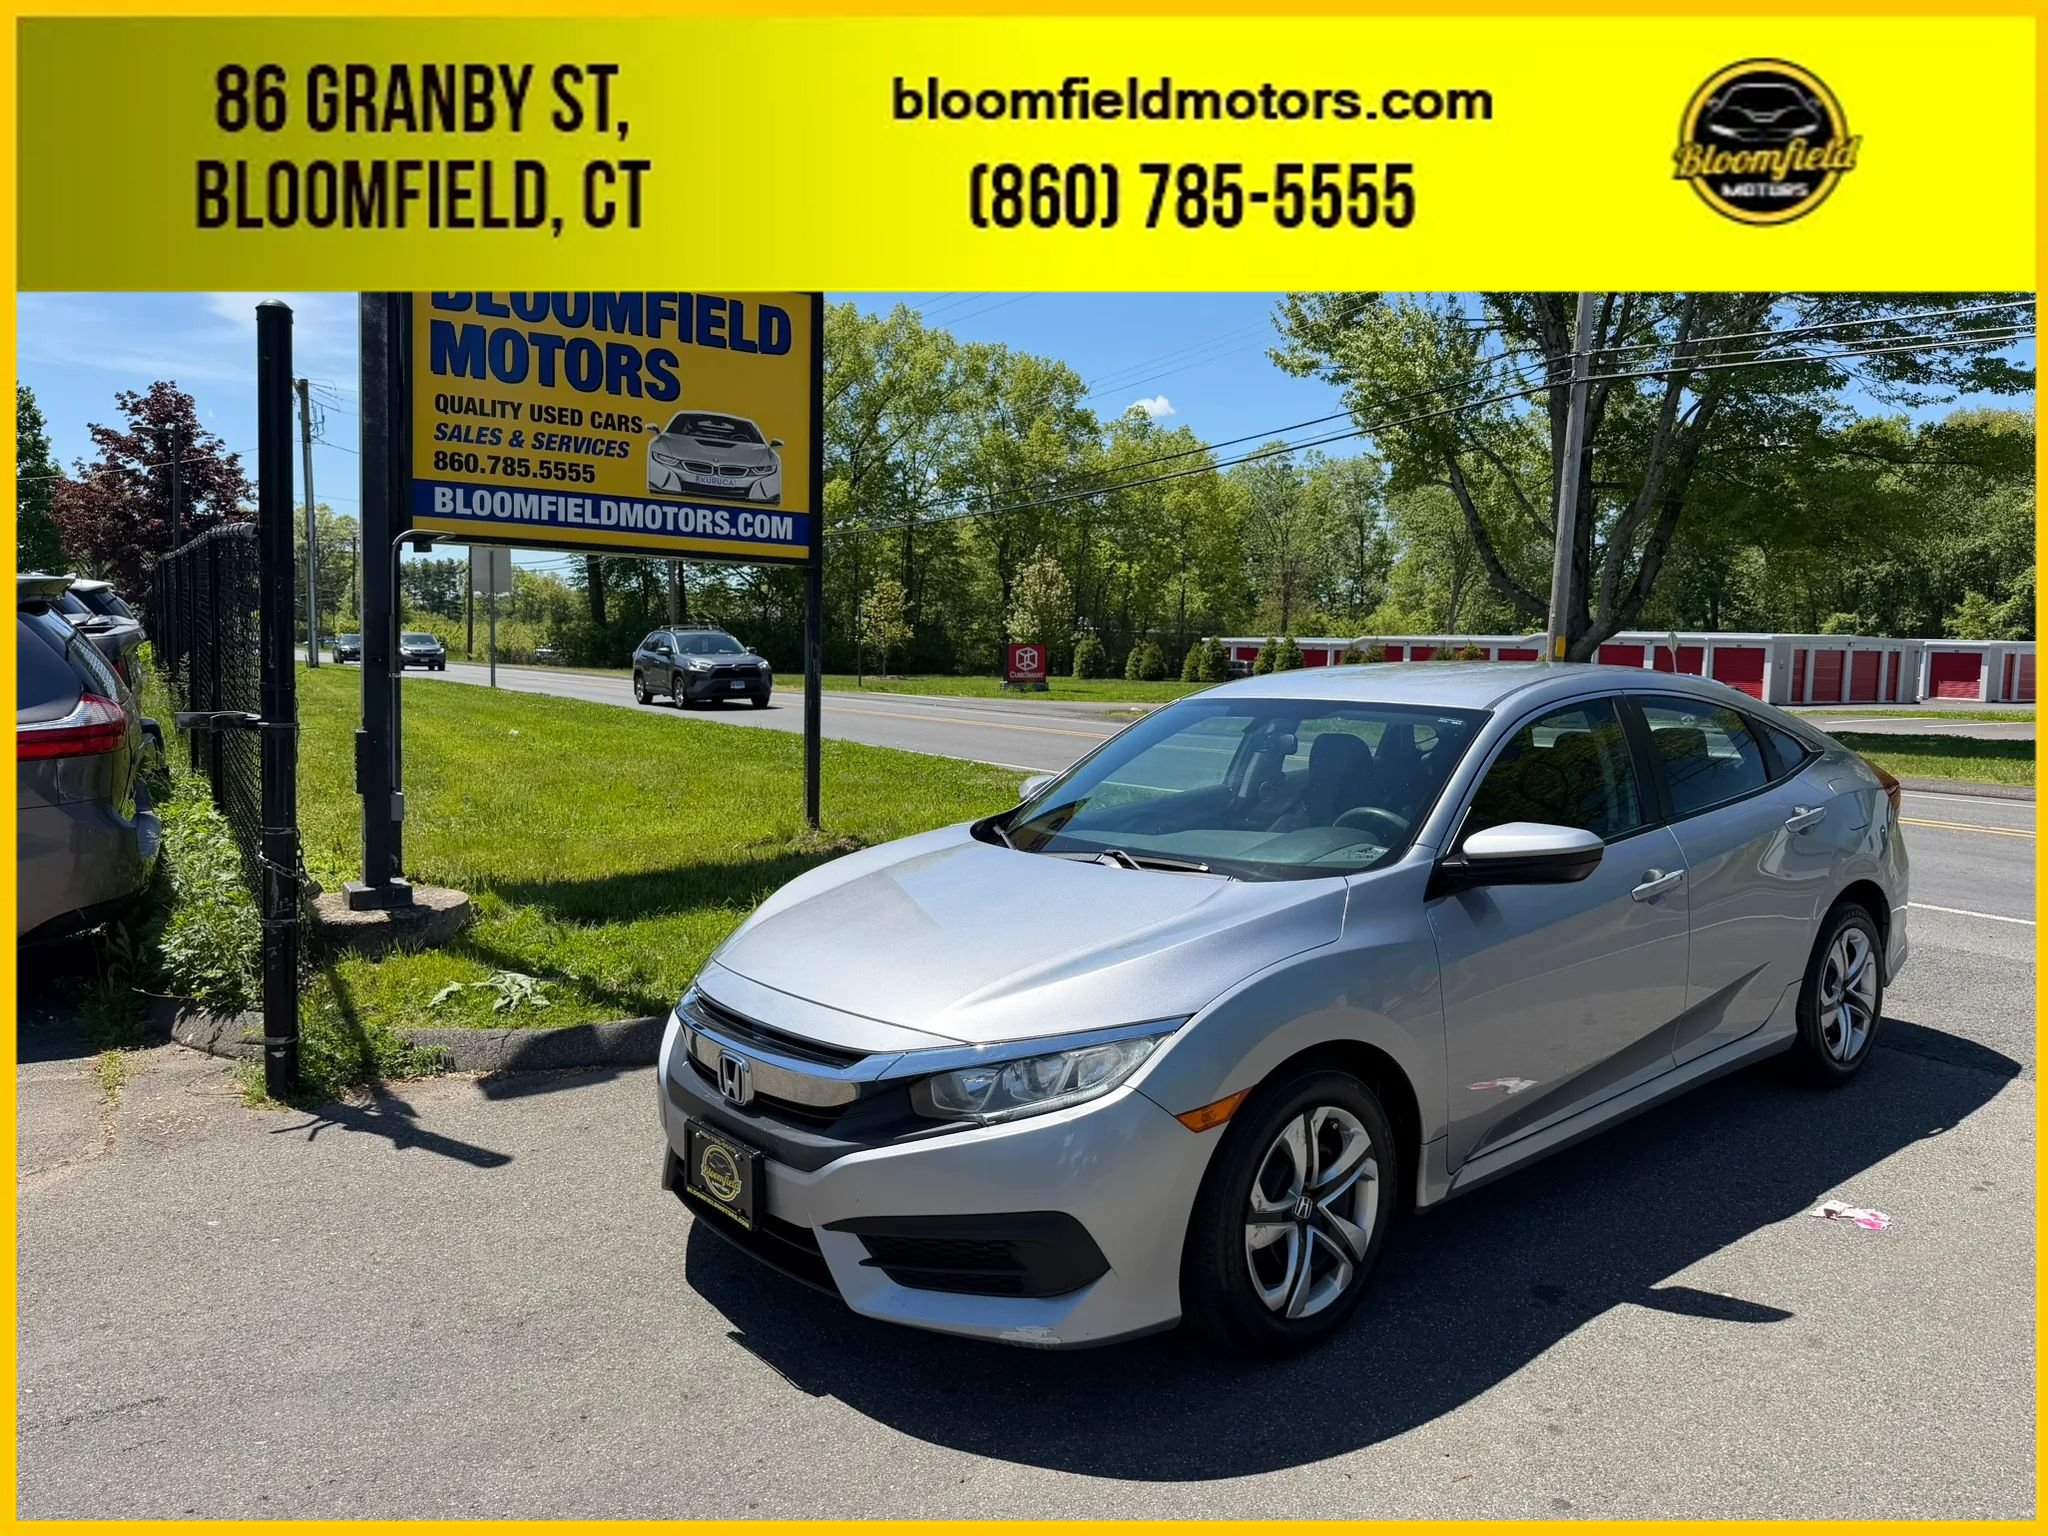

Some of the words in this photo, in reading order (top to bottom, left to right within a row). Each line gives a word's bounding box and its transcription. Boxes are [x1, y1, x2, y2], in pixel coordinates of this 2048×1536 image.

[430, 319, 681, 402] MOTORS
[434, 393, 523, 420] QUALITY
[529, 403, 583, 427] USED
[590, 411, 643, 434] CARS
[433, 422, 503, 446] SALES
[508, 430, 525, 448] &
[531, 432, 630, 459] SERVICES
[433, 450, 596, 484] 860.785.5555
[434, 486, 793, 541] BLOOMFIELDMOTORS.COM
